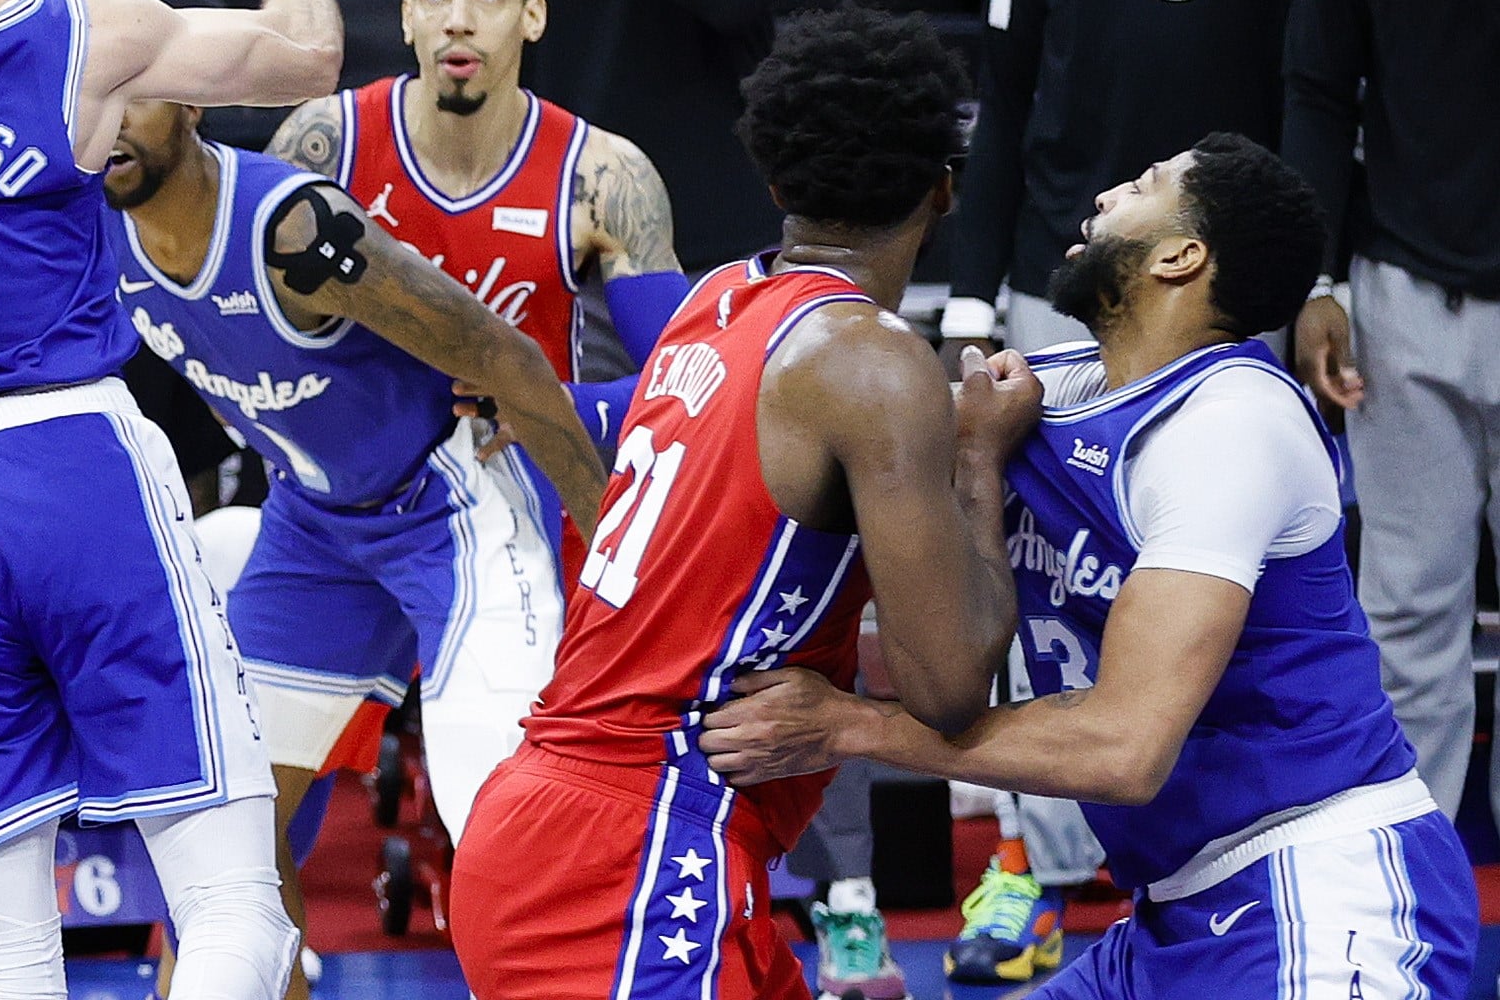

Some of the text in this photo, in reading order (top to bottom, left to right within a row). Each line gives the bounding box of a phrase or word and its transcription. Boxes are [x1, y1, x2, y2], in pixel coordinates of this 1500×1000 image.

[185, 359, 332, 420] Angeles
[1073, 438, 1109, 468] wish
[579, 424, 687, 609] 21
[1007, 506, 1123, 607] Angles
